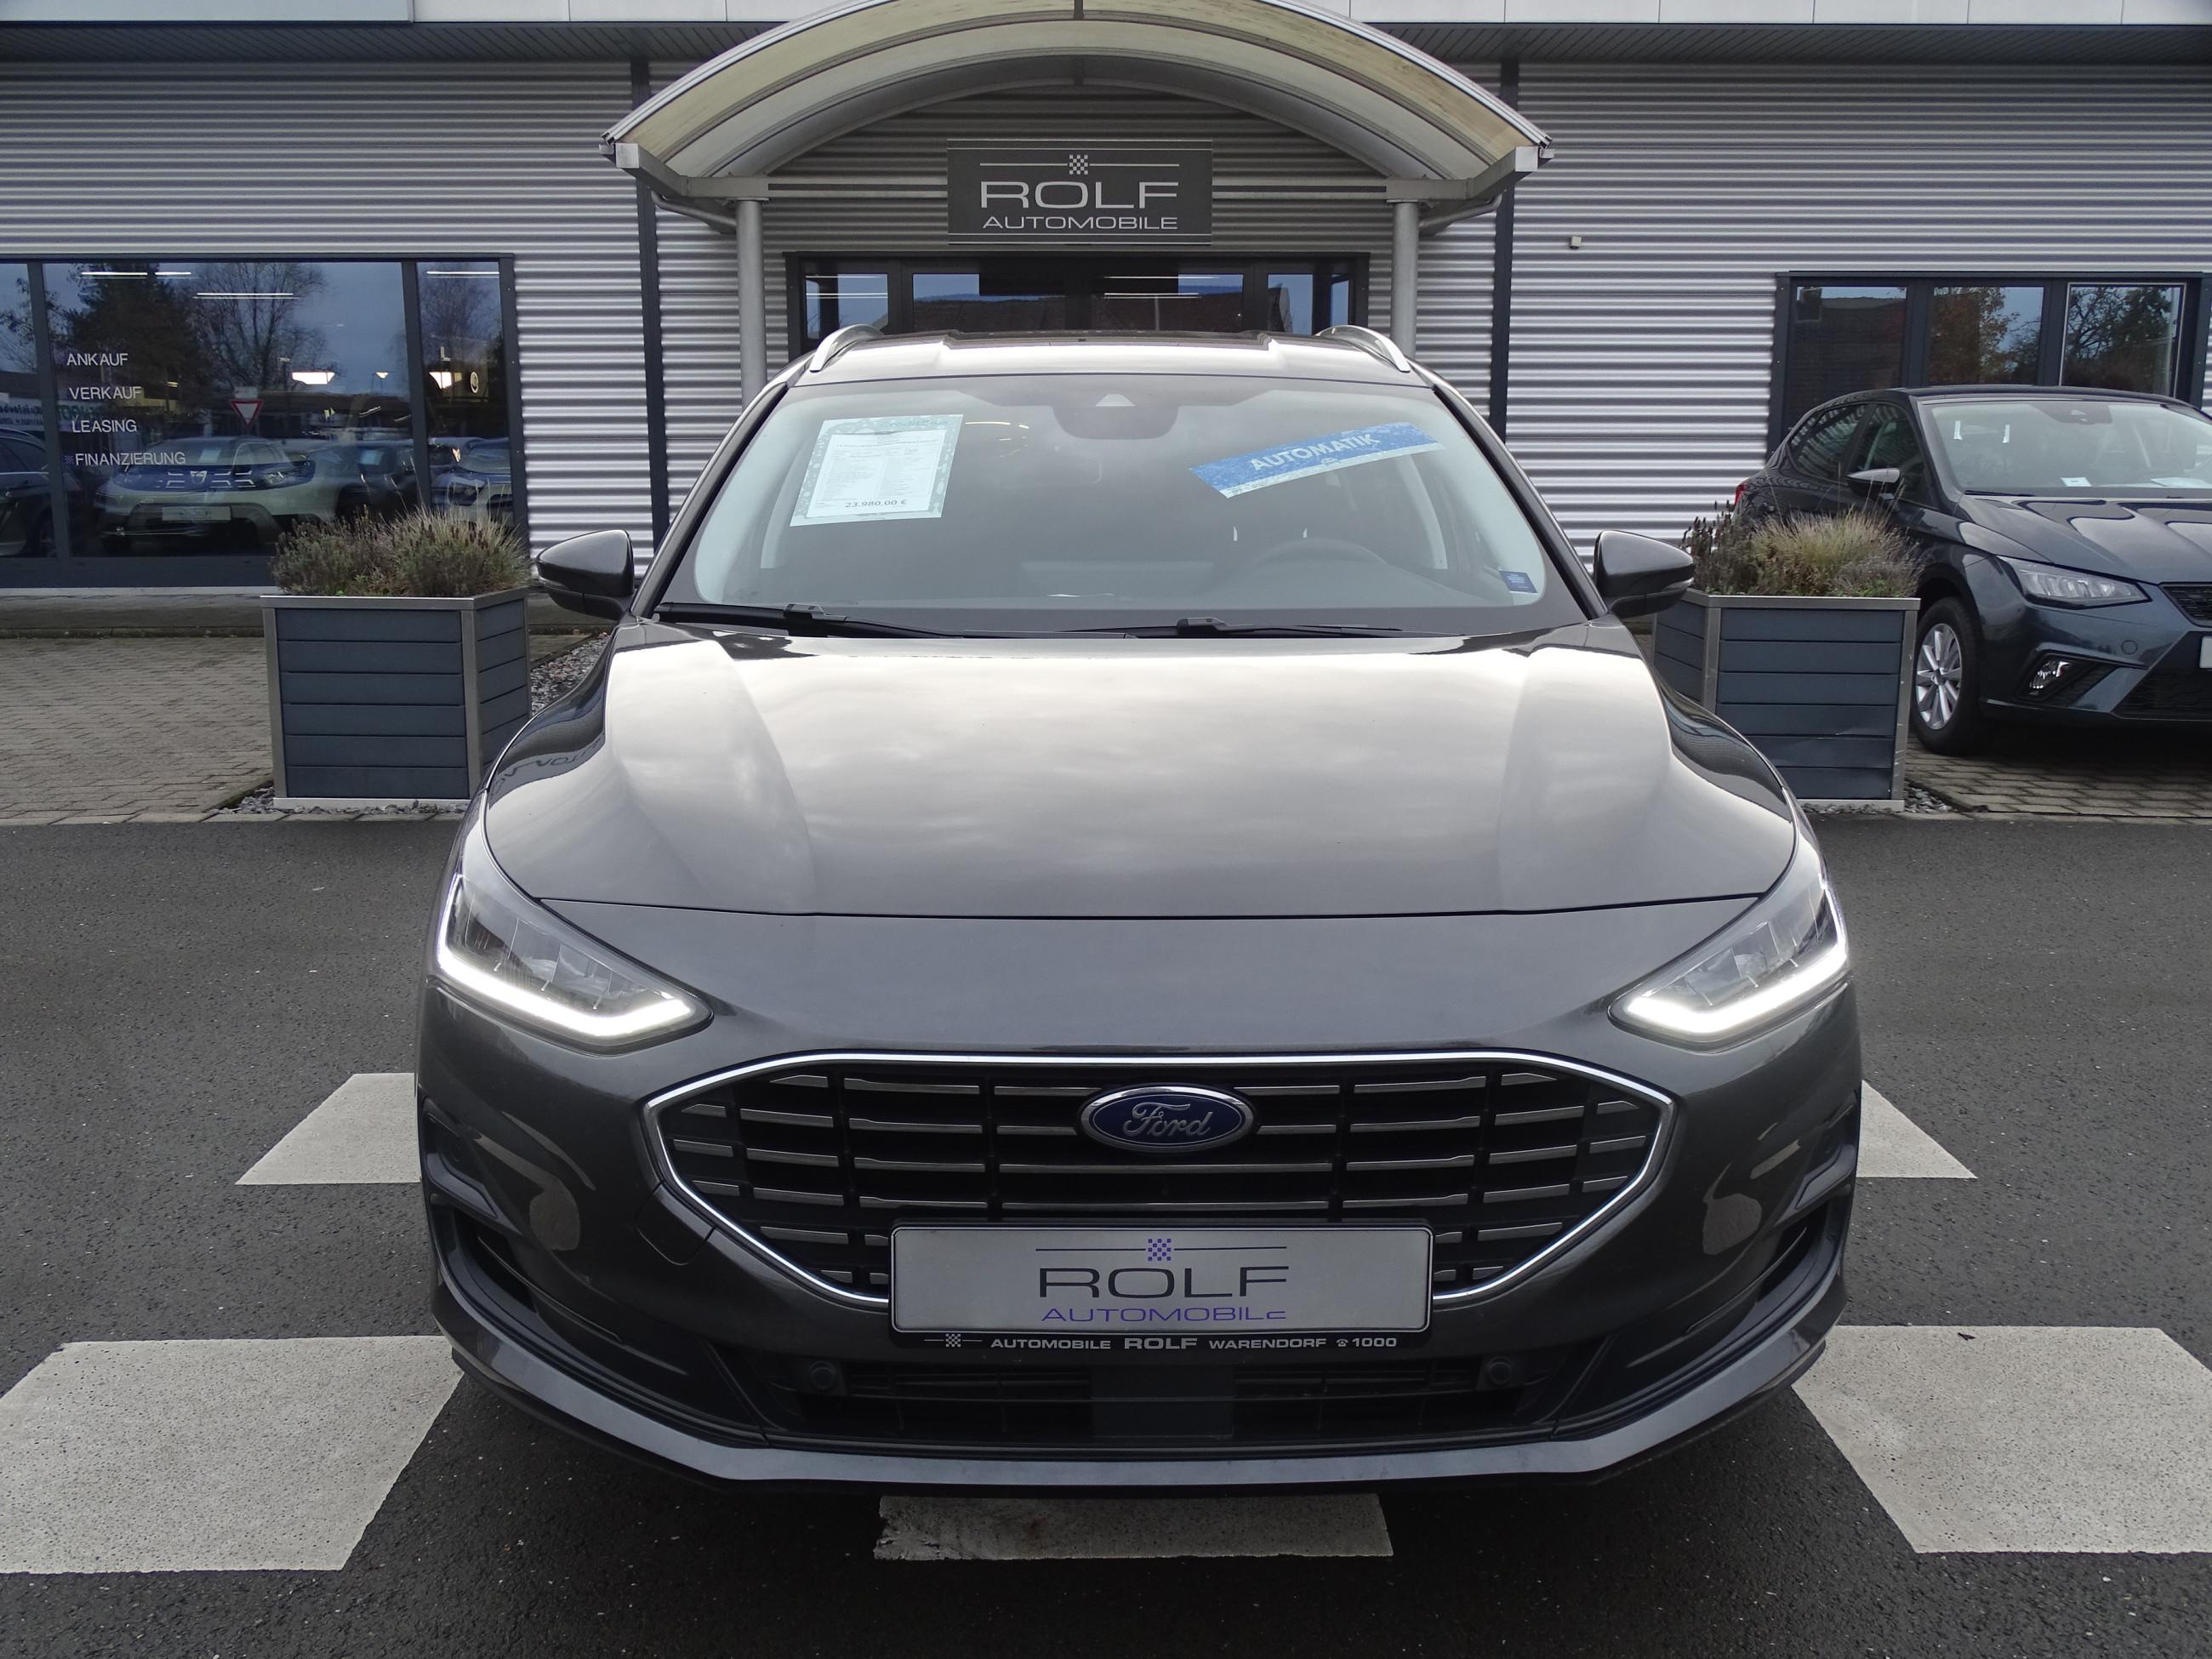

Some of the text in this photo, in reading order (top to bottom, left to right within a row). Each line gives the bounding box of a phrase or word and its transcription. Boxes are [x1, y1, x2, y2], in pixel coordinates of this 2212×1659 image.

[980, 180, 1179, 209] ROLF
[982, 216, 1178, 230] AUTOMOBILE
[66, 353, 128, 367] ANKAUF
[69, 385, 142, 400] VERKAUF
[71, 419, 138, 433] LEASING
[75, 451, 186, 465] FINANZIERUNG
[1251, 434, 1382, 470] AUTOMATIK
[844, 499, 898, 508] 23.980,00
[1122, 1102, 1214, 1137] Ford
[1039, 1266, 1289, 1298] ROLF
[990, 1339, 1111, 1350] AUTOMOBILE
[1124, 1337, 1198, 1350] ROLF
[1208, 1338, 1327, 1349] WARENDORF
